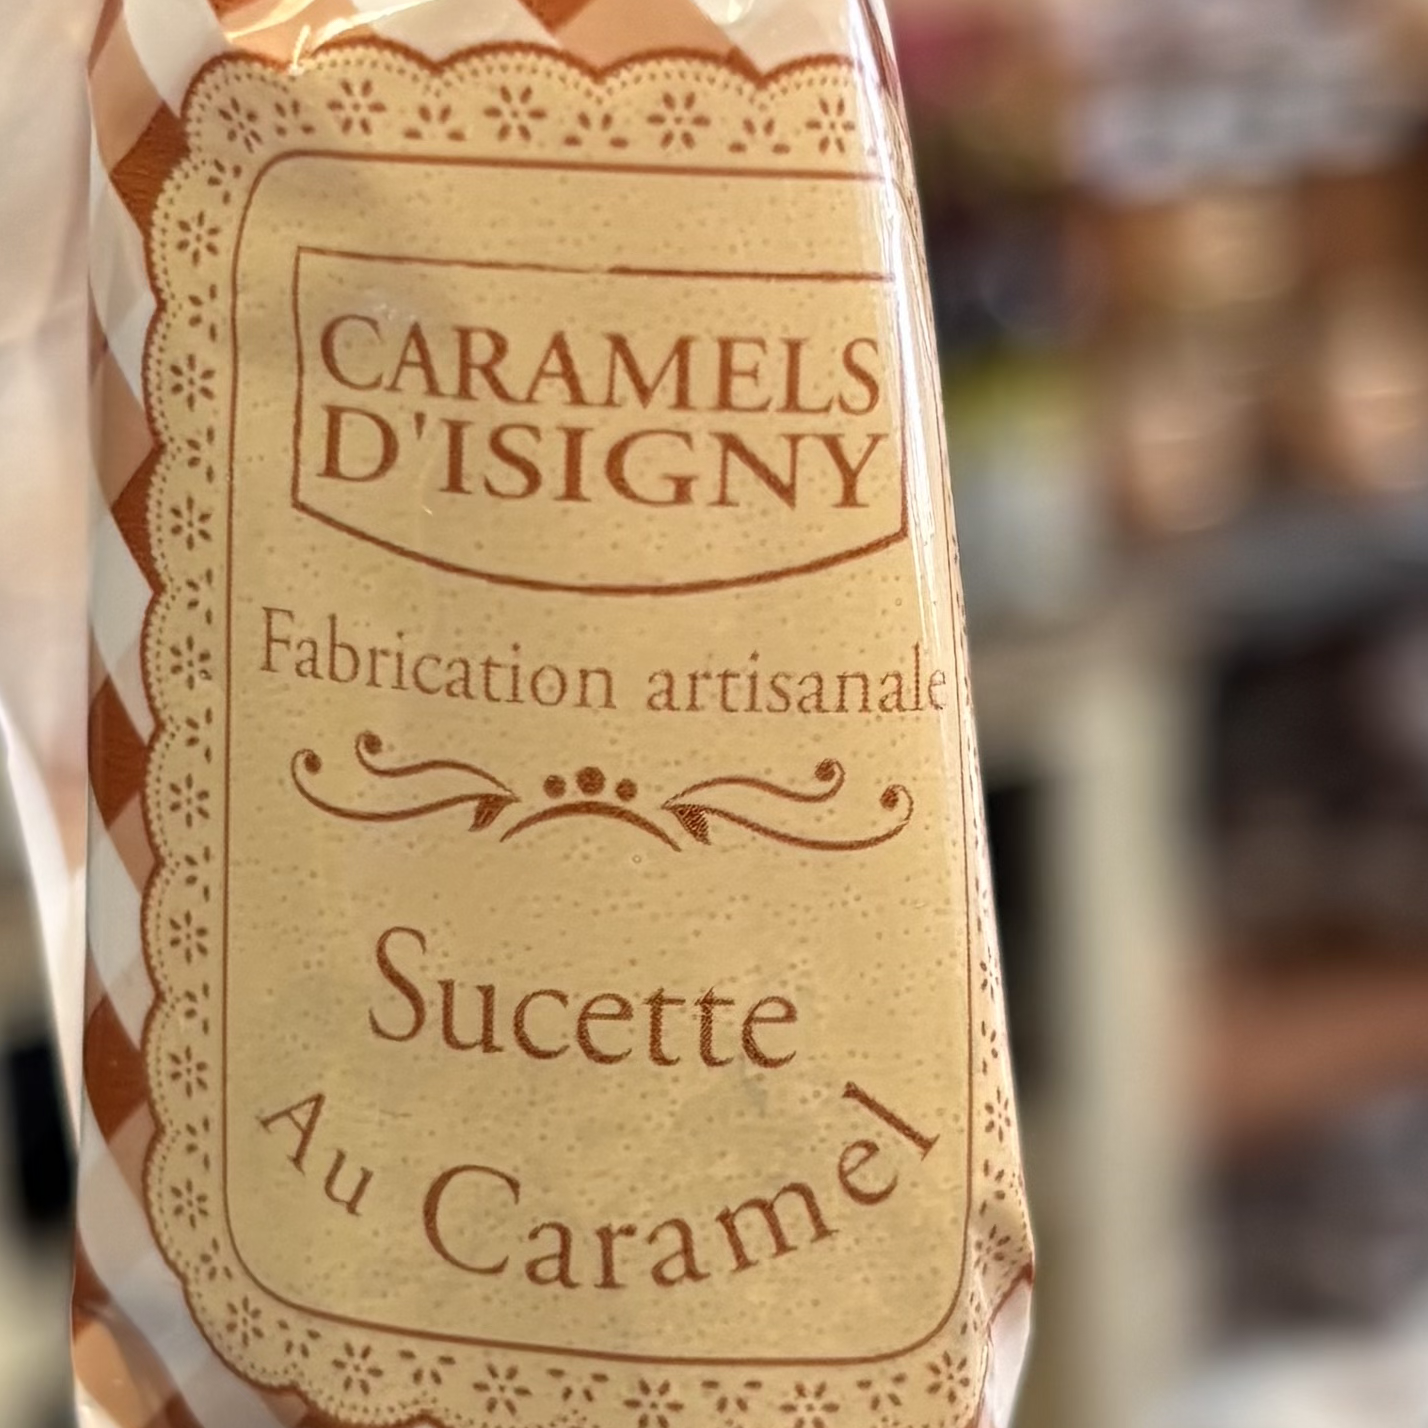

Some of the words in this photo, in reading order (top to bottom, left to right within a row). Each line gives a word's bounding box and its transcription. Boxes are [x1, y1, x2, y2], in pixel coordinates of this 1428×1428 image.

[319, 314, 881, 417] CARAMELS
[315, 404, 890, 510] D'ISIGNY
[259, 606, 618, 711] Fabrication
[646, 643, 948, 714] artisanale
[368, 925, 799, 1069] Sucette
[256, 1092, 374, 1216] Au
[422, 1080, 942, 1290] Caramel
